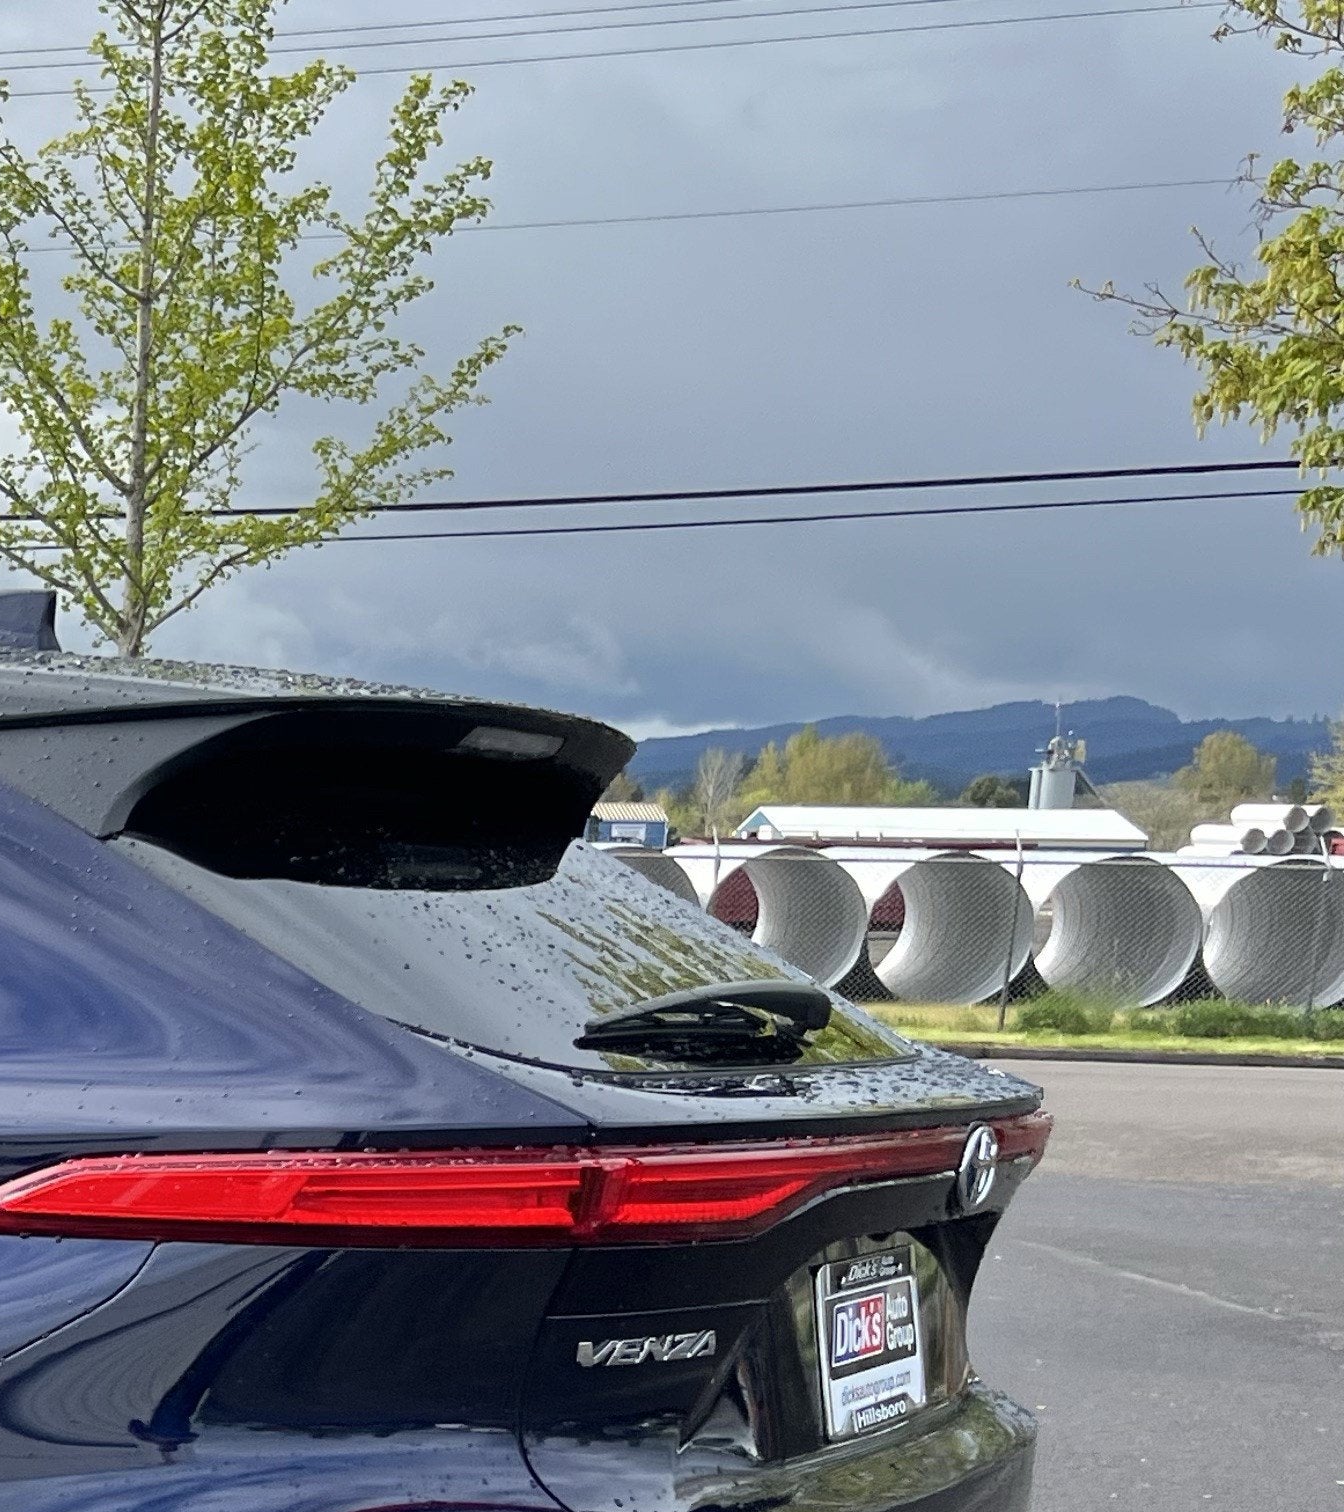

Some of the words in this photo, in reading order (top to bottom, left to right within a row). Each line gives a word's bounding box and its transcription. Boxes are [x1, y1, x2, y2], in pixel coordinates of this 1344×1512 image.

[836, 1301, 882, 1357] Dick's
[886, 1322, 915, 1351] Group
[576, 1329, 717, 1367] VENZA
[857, 1400, 906, 1429] Hillsboro
